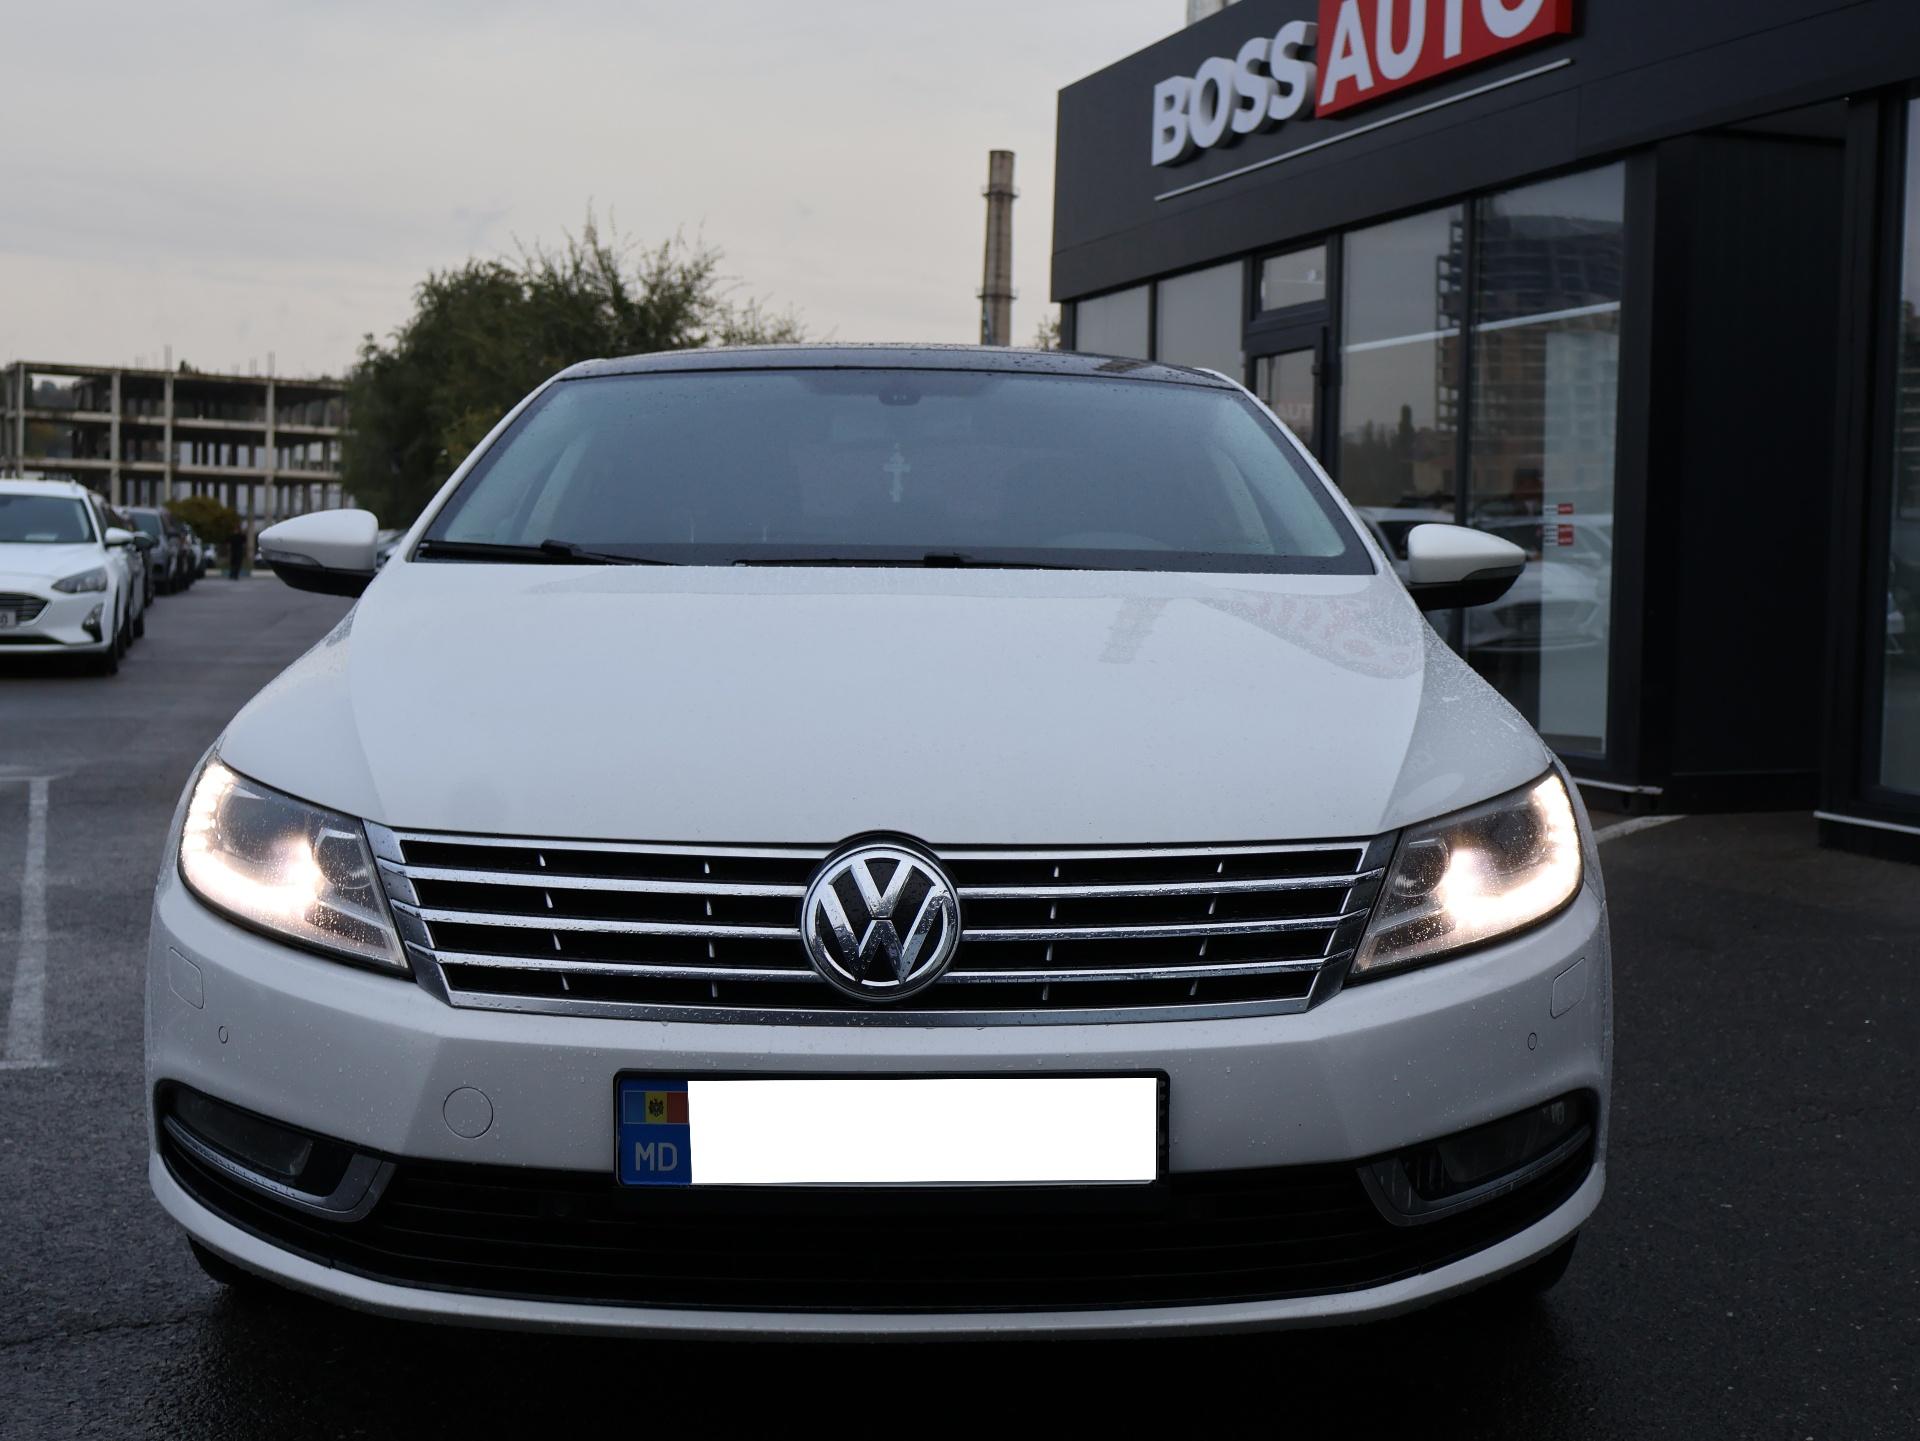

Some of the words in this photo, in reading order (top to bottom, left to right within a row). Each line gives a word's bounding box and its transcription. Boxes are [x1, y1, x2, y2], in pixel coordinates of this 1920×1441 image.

[1152, 20, 1315, 166] BOSS
[803, 845, 960, 999] VW
[635, 1142, 678, 1172] MD
